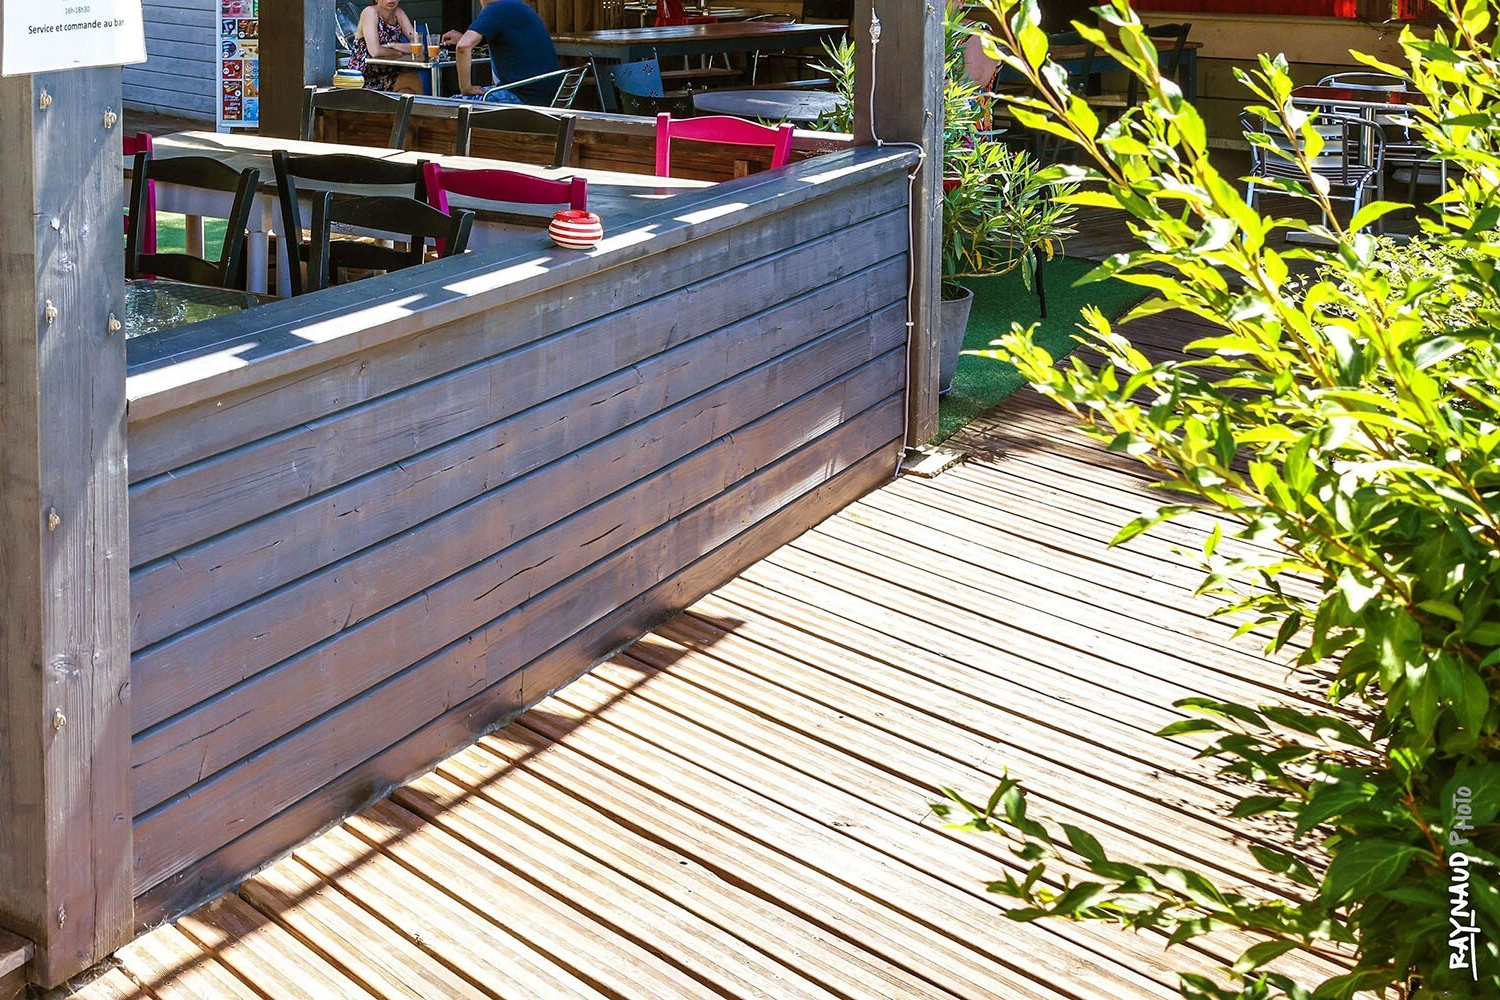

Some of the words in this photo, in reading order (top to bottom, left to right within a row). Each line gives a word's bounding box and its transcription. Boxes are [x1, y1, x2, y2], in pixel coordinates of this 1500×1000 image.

[28, 24, 54, 34] Service
[55, 24, 63, 32] et
[64, 19, 102, 31] commande
[103, 20, 113, 28] au
